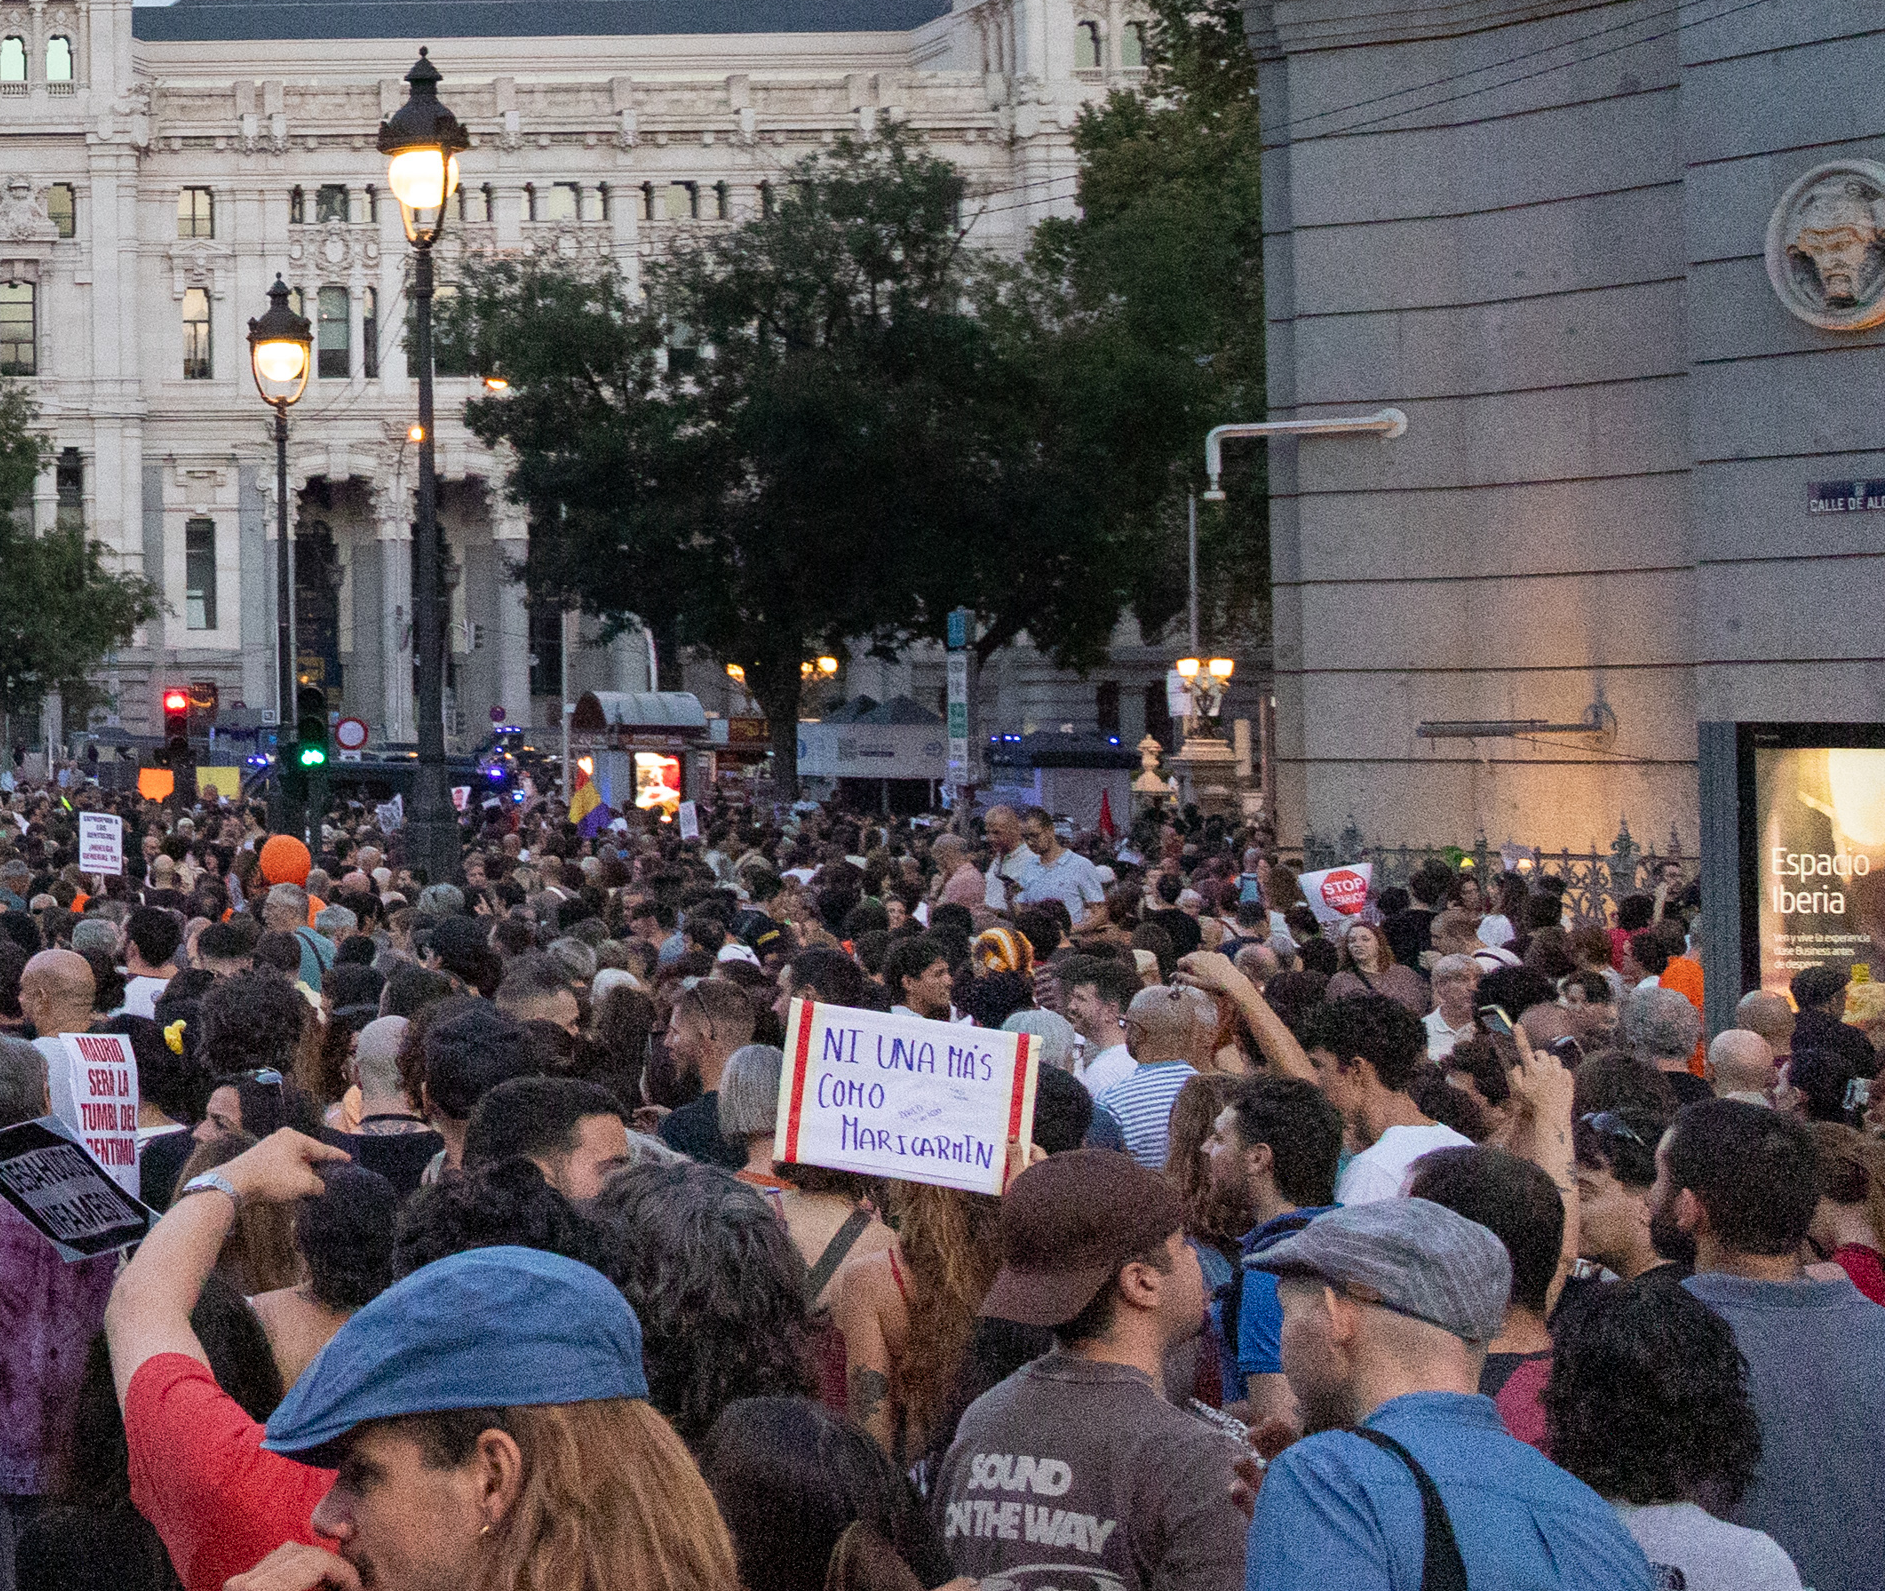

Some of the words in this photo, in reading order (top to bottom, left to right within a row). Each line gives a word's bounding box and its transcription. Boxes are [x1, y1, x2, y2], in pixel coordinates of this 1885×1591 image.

[1810, 497, 1845, 512] CALLE
[1847, 497, 1864, 511] DE
[1771, 846, 1870, 883] Espacio
[1323, 877, 1363, 895] STOP
[1772, 884, 1846, 914] Iberia
[1795, 946, 1831, 956] Business
[1824, 932, 1870, 944] experiencia
[75, 1037, 126, 1063] MADRID
[823, 1027, 864, 1063] NI
[877, 1034, 935, 1074] UNA
[947, 1044, 993, 1081] MÁS
[87, 1064, 115, 1097] SERÁ
[117, 1069, 130, 1097] LA
[818, 1072, 885, 1109] COMO
[119, 1105, 137, 1132] DEL
[968, 1453, 1072, 1497] SOUND
[973, 1500, 1023, 1540] THE
[1024, 1503, 1117, 1555] WAY
